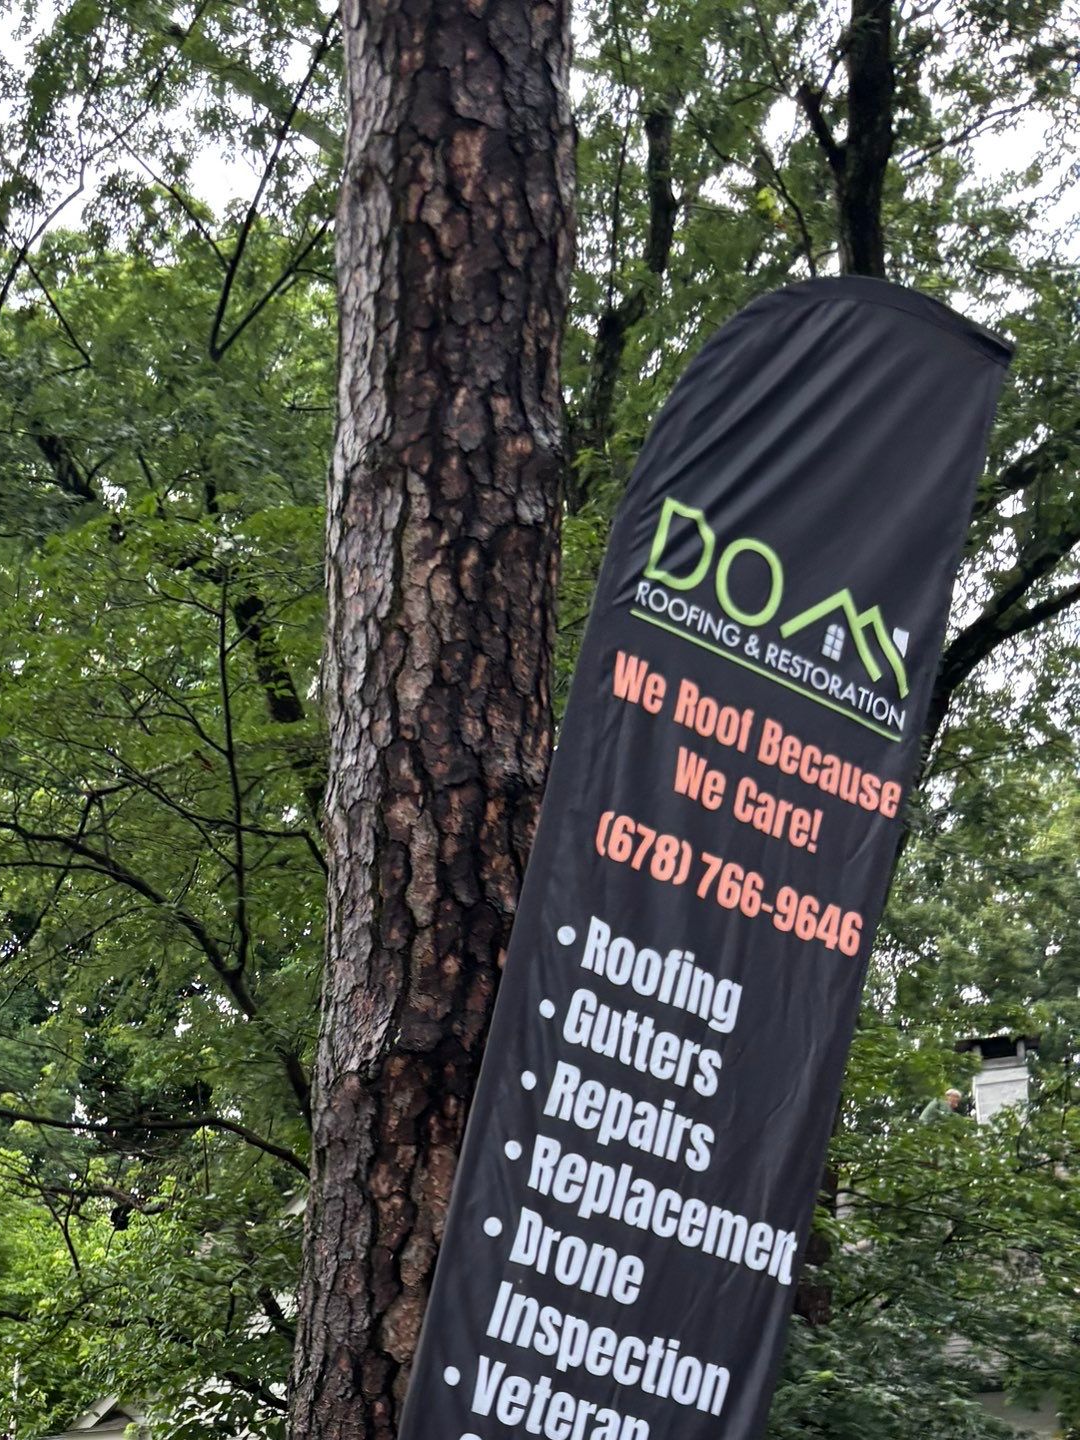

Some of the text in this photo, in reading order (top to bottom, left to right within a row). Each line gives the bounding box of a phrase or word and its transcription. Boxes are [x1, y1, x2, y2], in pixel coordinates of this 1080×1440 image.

[635, 582, 906, 733] ROOFING & RESTORATION
[612, 650, 902, 819] We Roof Because
[673, 746, 824, 854] We Care!
[595, 810, 863, 957] (678) 766-9646
[580, 915, 743, 1033] Roofing
[563, 989, 722, 1097] Gutters
[543, 1060, 715, 1172] Repairs
[509, 1207, 645, 1304] Drone
[528, 1135, 798, 1286] Replacement
[486, 1281, 730, 1415] Inspection
